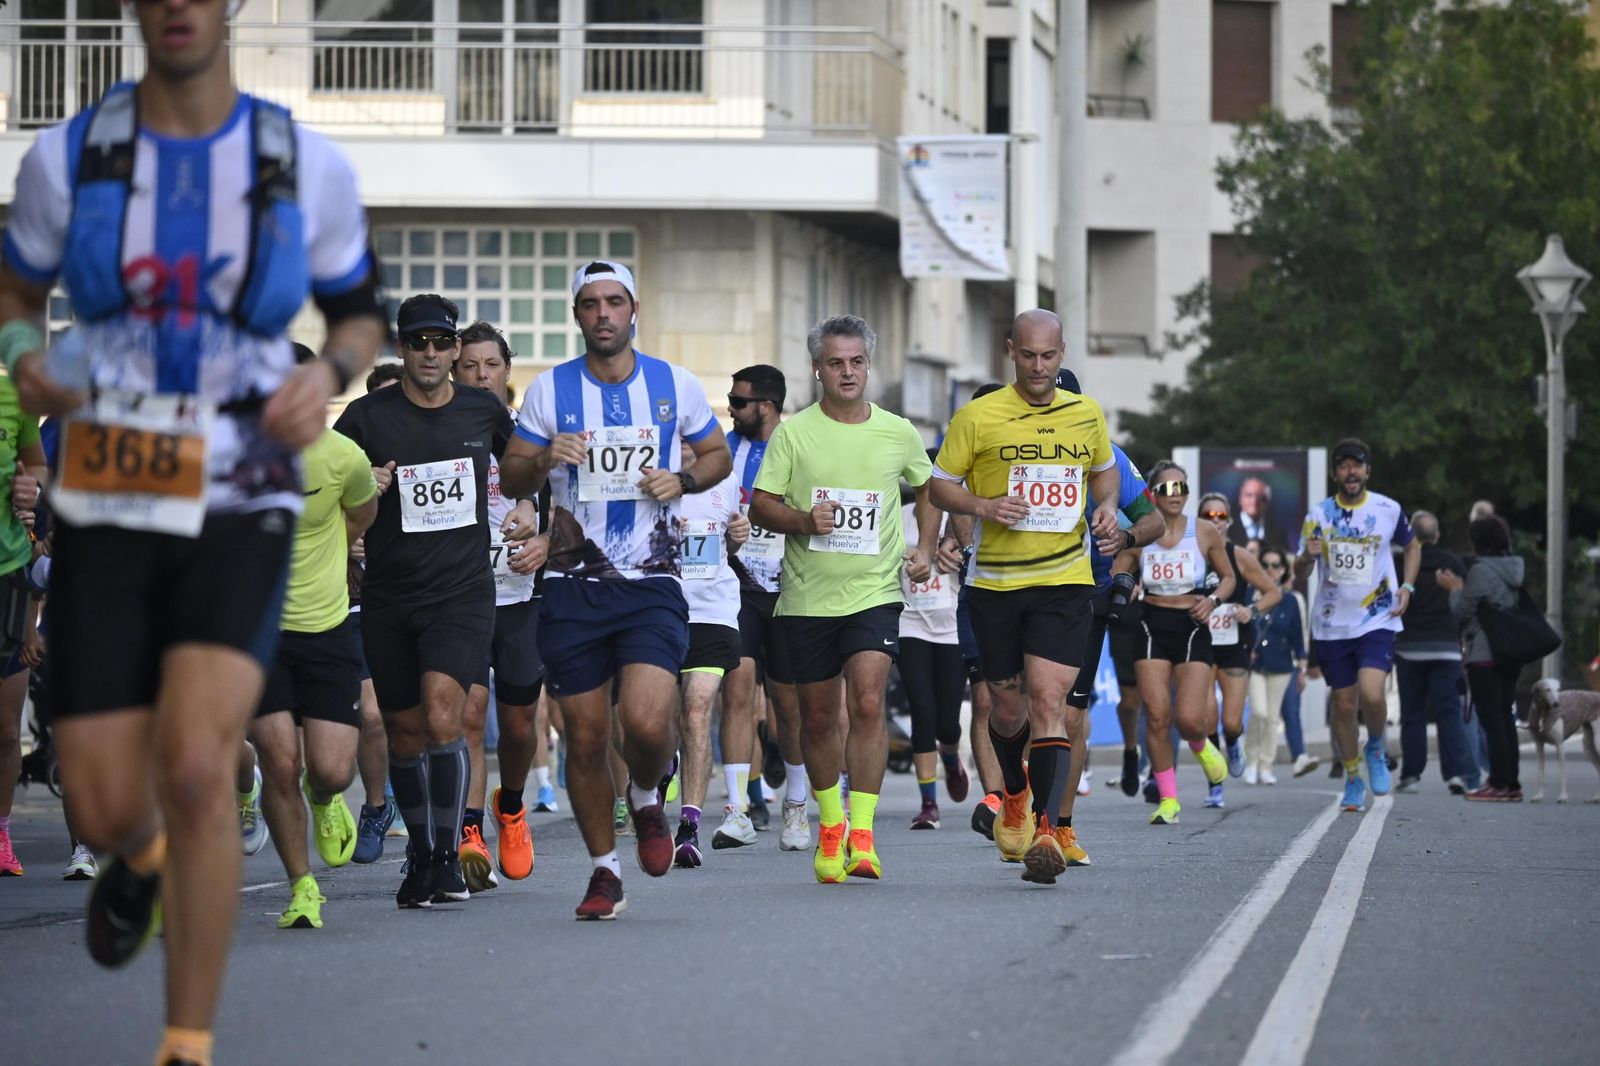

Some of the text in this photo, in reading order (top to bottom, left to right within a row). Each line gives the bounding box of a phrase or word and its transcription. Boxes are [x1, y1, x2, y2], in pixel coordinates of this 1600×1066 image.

[638, 428, 655, 441] 2K
[1037, 427, 1056, 435] vive
[83, 424, 180, 480] 368
[999, 443, 1091, 461] OSUNA
[586, 445, 655, 473] 1072
[454, 460, 469, 473] 2K
[1013, 466, 1029, 478] 2K
[1064, 467, 1078, 479] 2K
[402, 467, 418, 480] 2K
[412, 477, 465, 507] 864
[600, 484, 635, 495] Huelva
[816, 489, 830, 501] 2K
[1012, 481, 1078, 508] 1089
[866, 492, 880, 504] 2K
[422, 515, 455, 526] Huelva
[832, 506, 876, 531] 081
[1026, 517, 1059, 527] Huelva
[707, 522, 717, 532] 2K
[750, 525, 777, 539] 92
[741, 545, 767, 554] Huelva
[827, 539, 859, 549] Huelva
[1335, 553, 1365, 570] 593
[1152, 562, 1184, 580] 861
